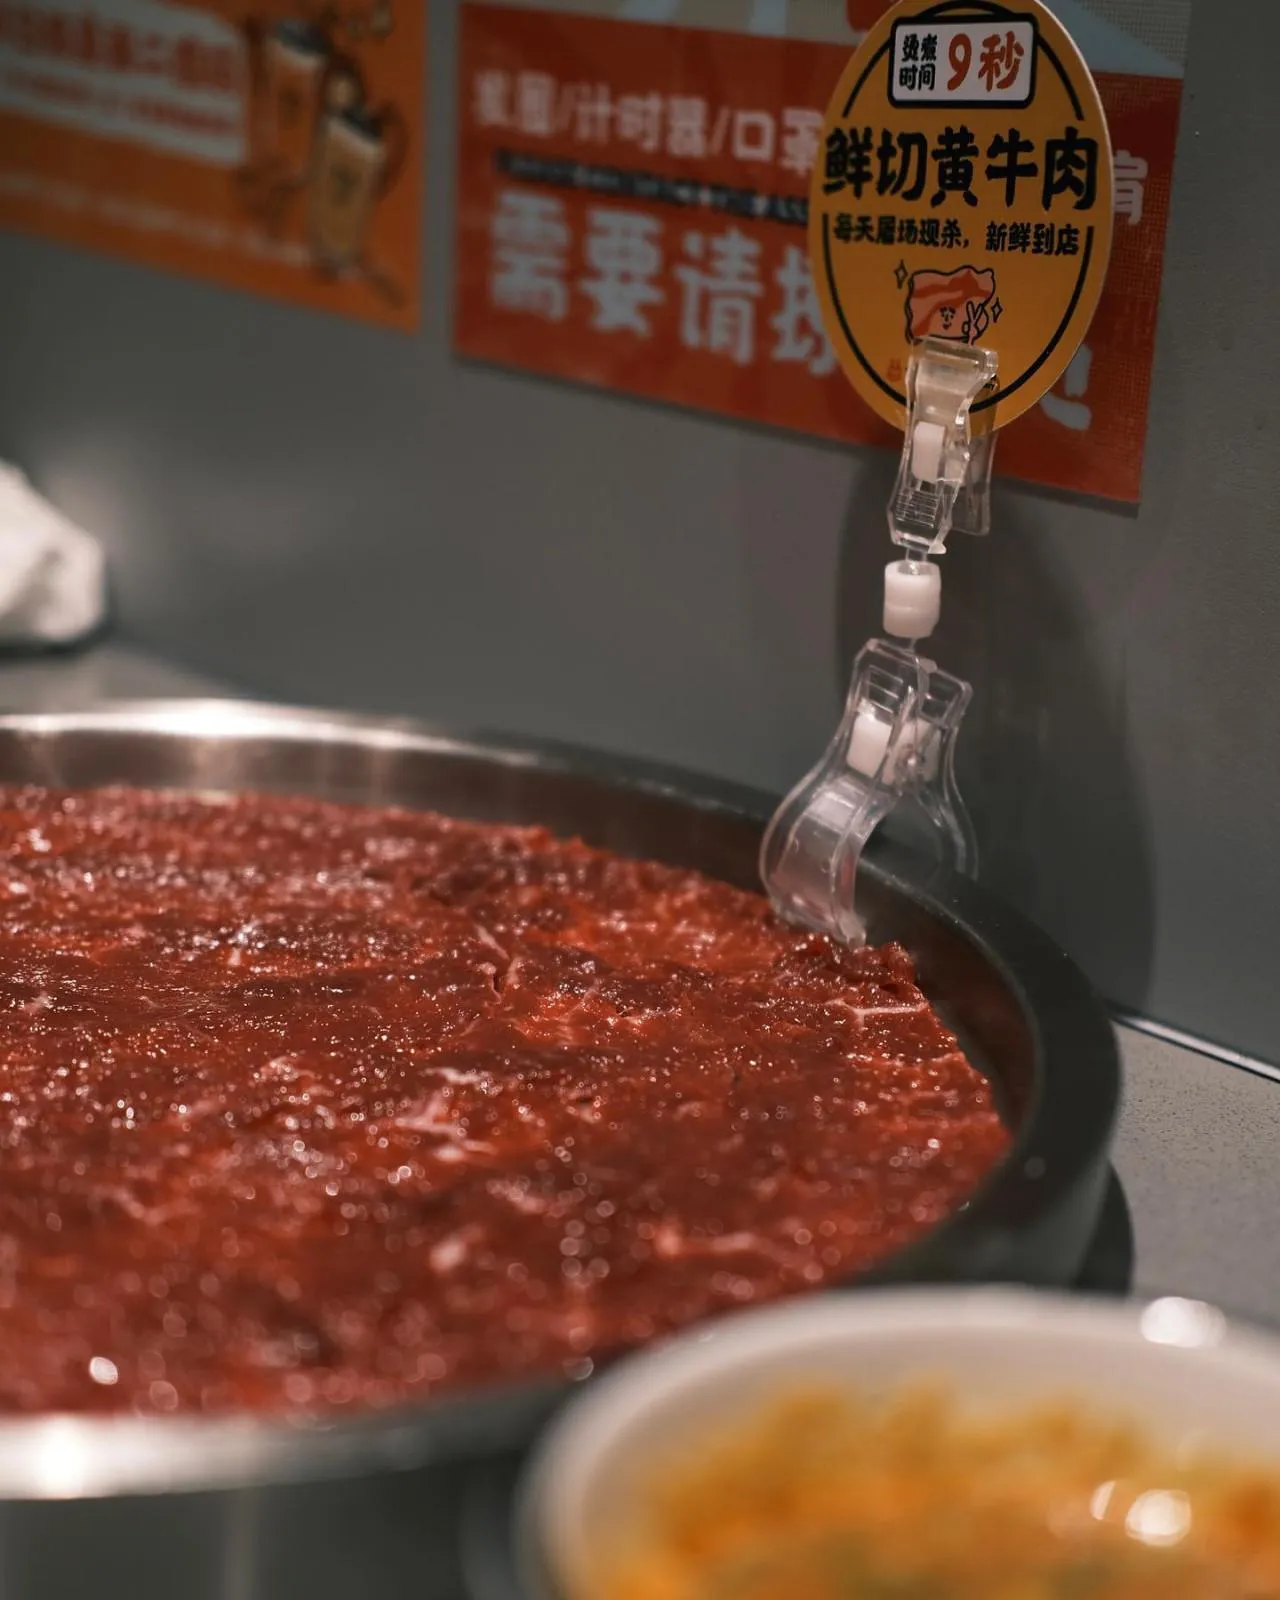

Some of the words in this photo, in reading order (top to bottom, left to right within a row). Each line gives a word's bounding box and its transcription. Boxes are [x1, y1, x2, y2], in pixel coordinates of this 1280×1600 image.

[902, 34, 938, 63] 烫煮
[947, 31, 1025, 93] 9秒
[899, 64, 936, 92] 时间
[822, 126, 1099, 211] 鲜切黄牛肉
